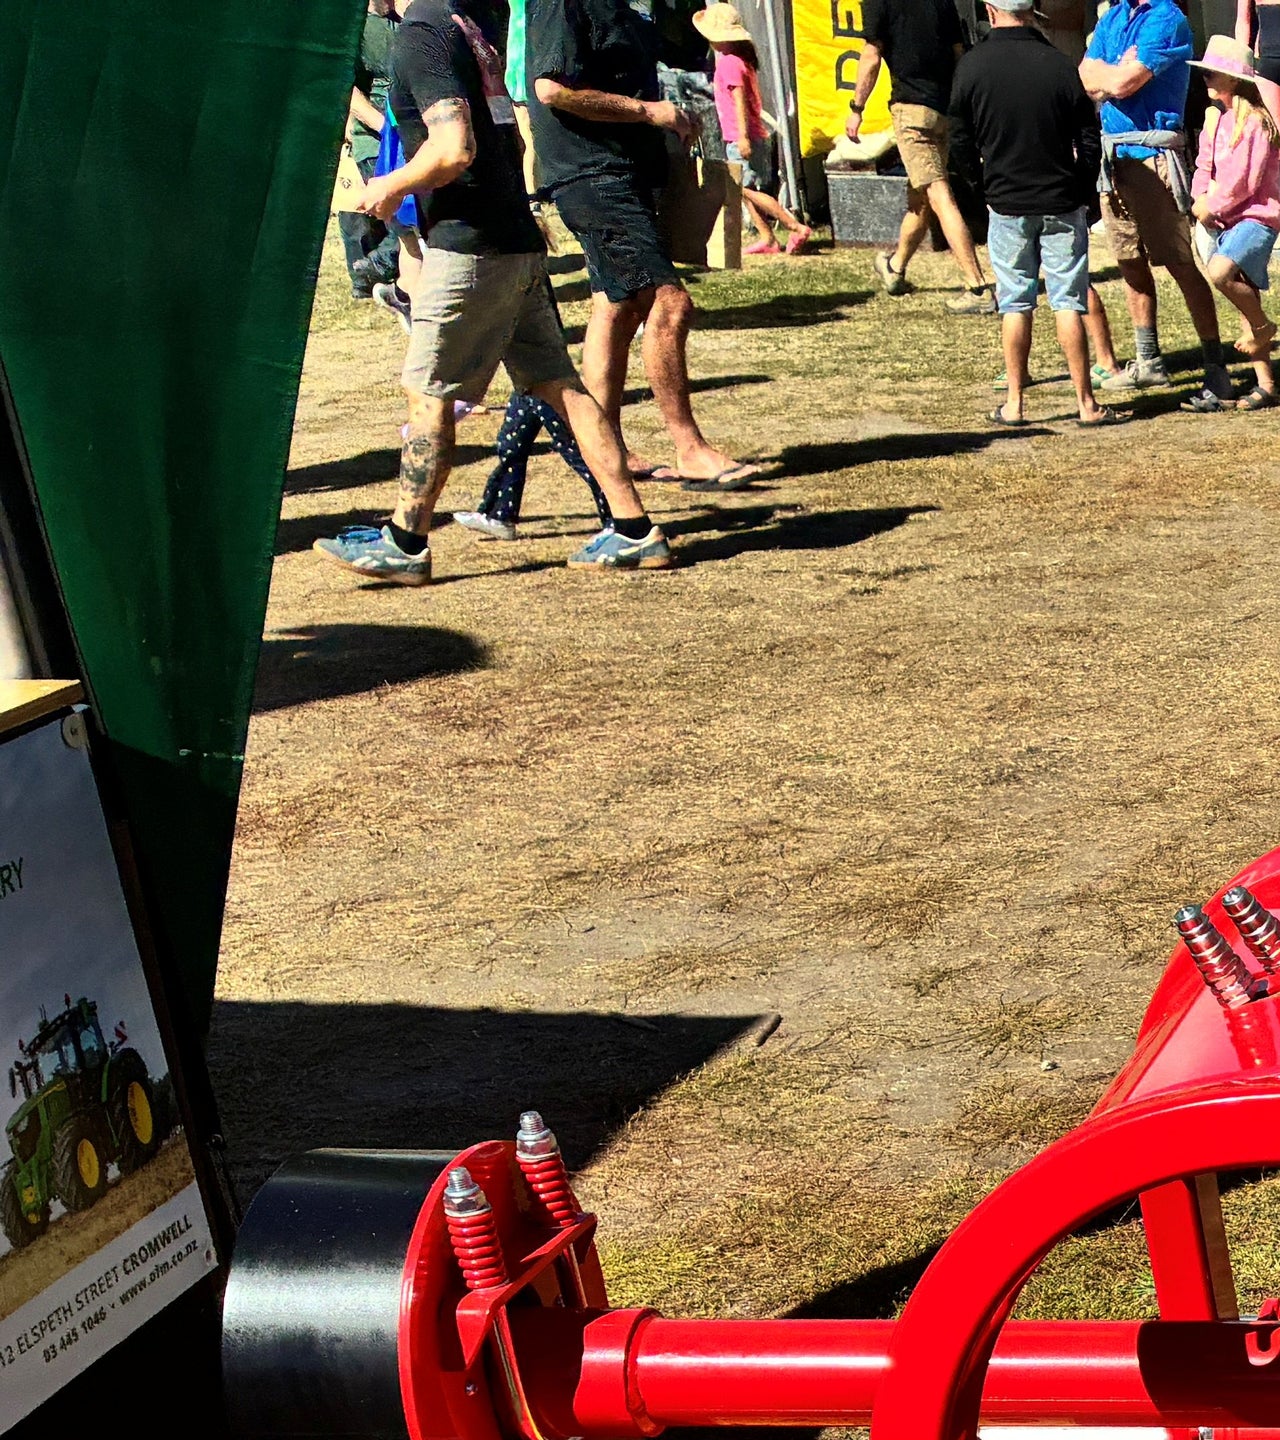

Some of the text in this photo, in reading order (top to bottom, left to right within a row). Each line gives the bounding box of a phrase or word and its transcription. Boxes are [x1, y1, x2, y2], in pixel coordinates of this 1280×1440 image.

[0, 856, 23, 898] RY
[17, 1302, 73, 1354] ELSPETH
[75, 1266, 119, 1311] STREET
[122, 1215, 192, 1275] CROMWELL
